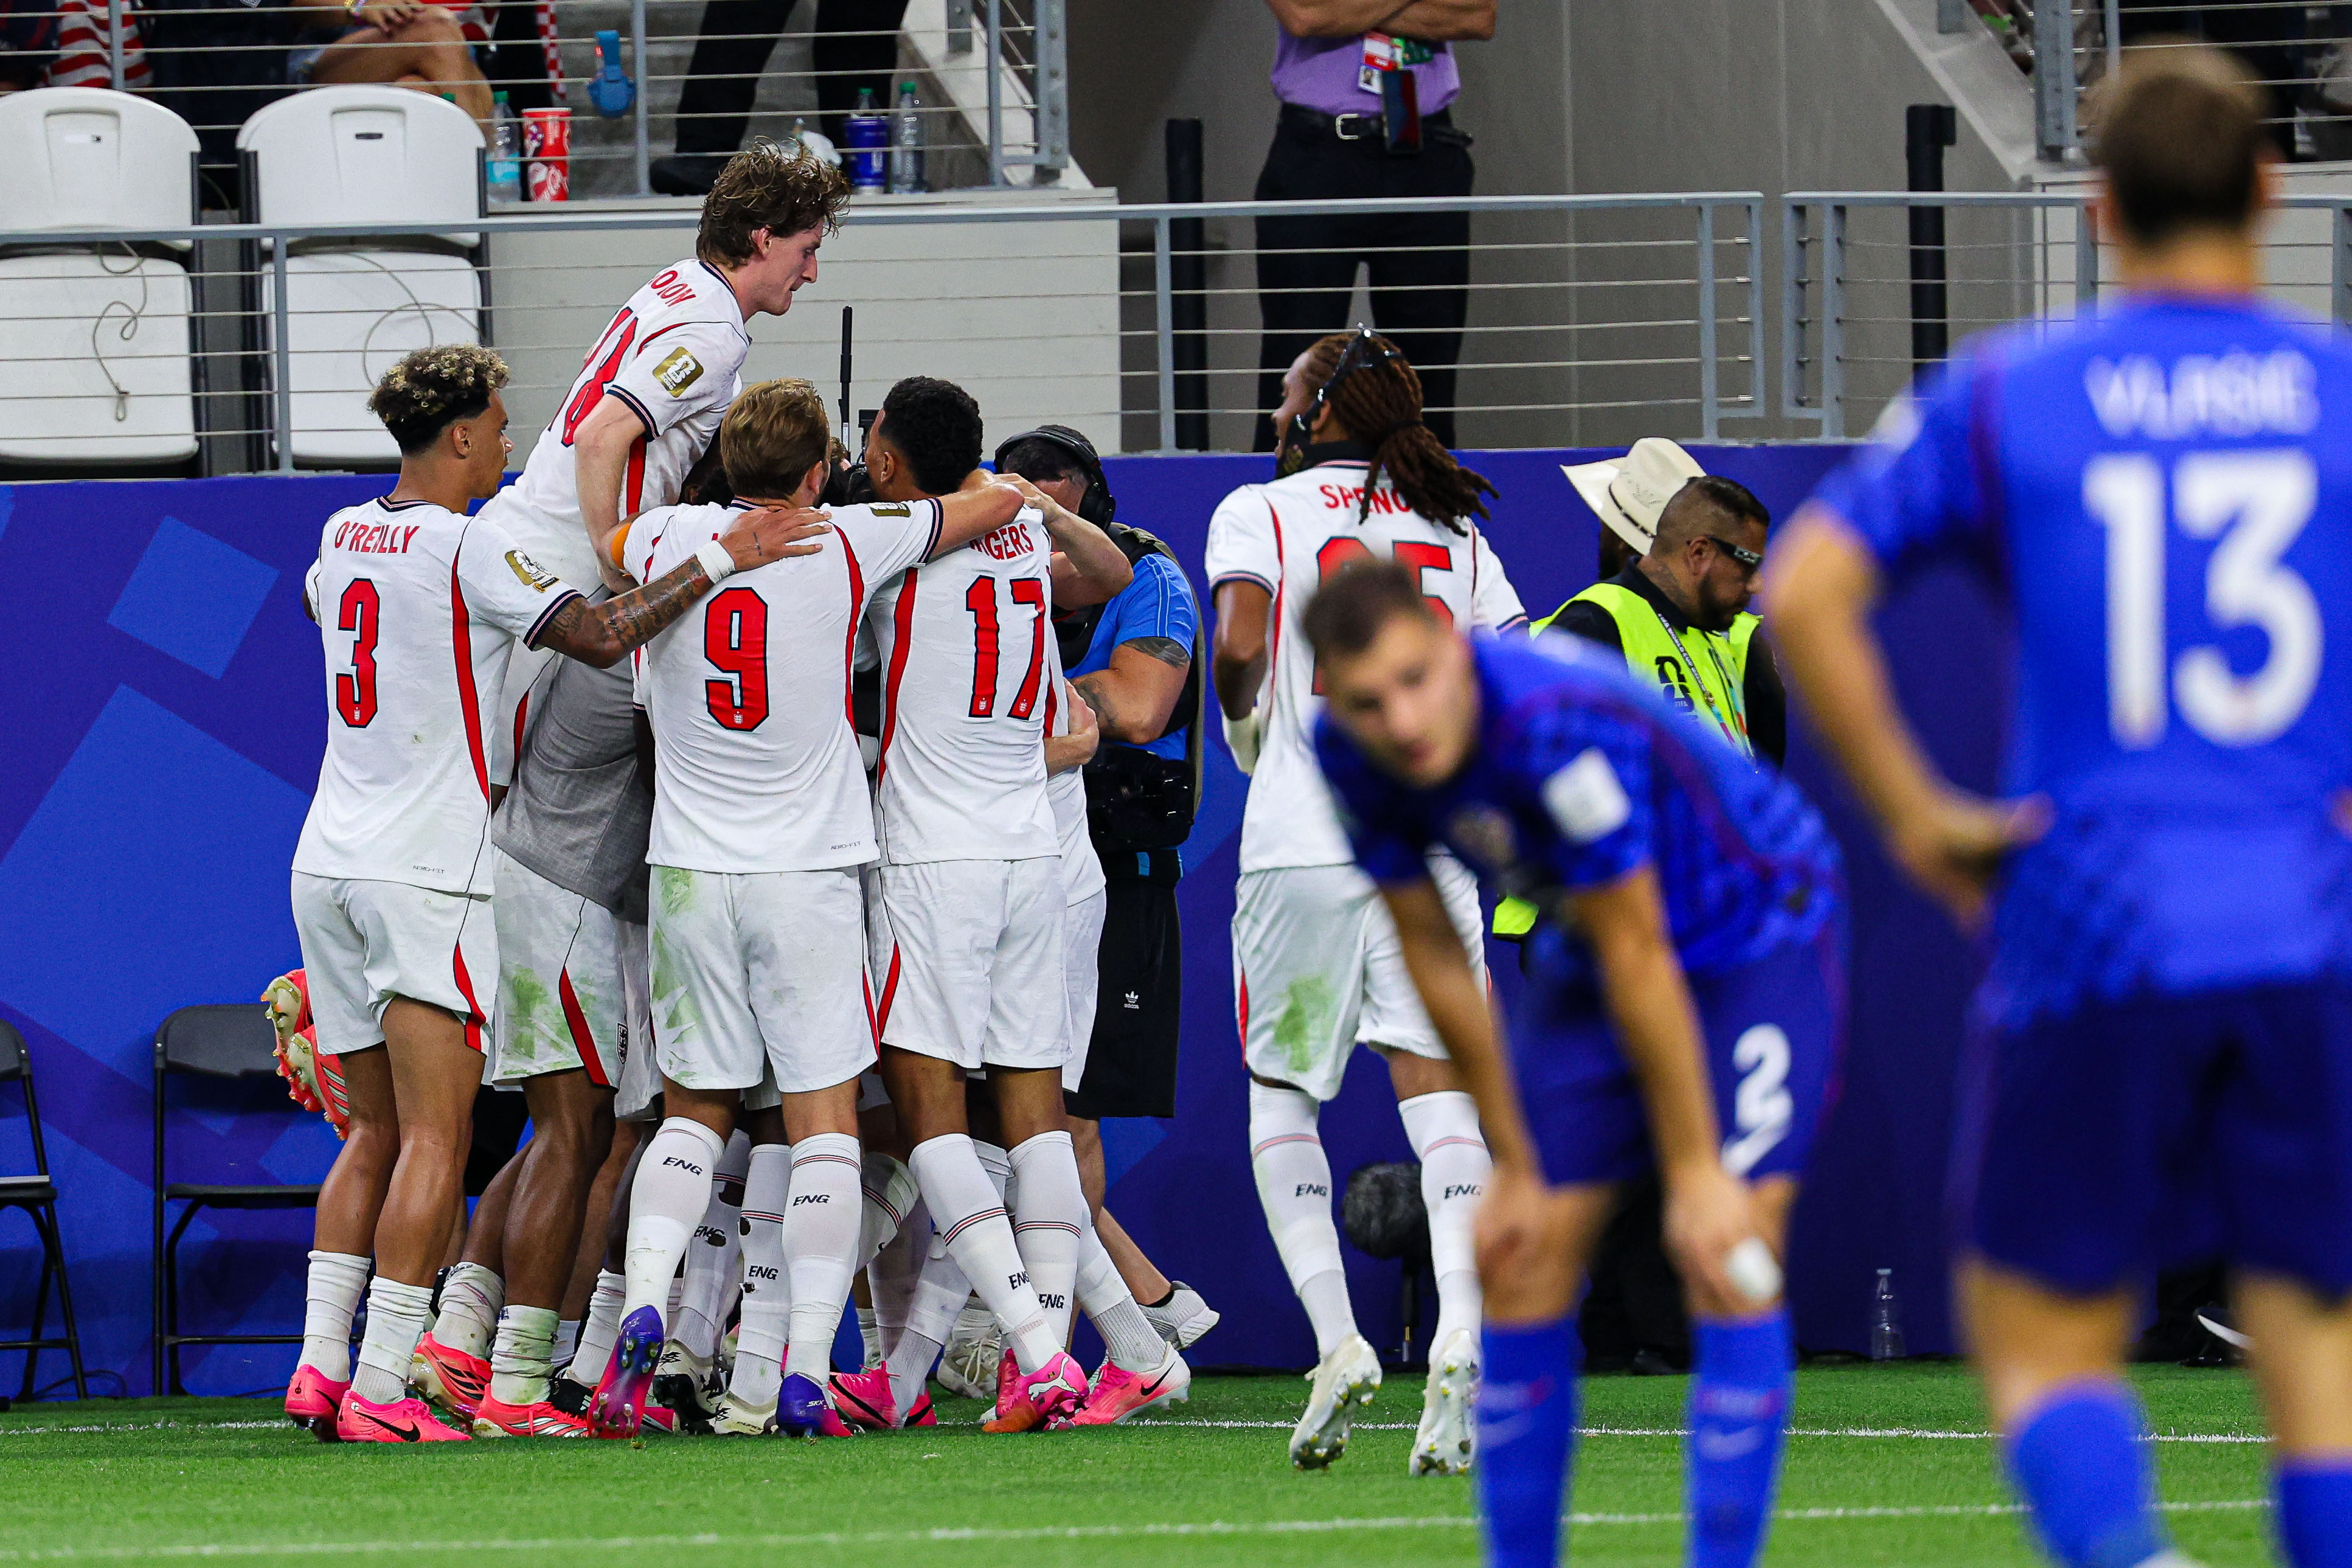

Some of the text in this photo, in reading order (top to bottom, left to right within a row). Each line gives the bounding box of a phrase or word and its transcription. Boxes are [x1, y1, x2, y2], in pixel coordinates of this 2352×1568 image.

[1319, 484, 1412, 515] SPENC
[335, 521, 420, 553] O'REILLY
[969, 523, 1035, 560] GERS
[2082, 449, 2325, 751] 13
[336, 578, 380, 728] 3
[704, 586, 770, 732] 9
[965, 575, 1046, 721] 17
[830, 841, 861, 850] AERO-FIT
[1733, 1022, 1794, 1130] 2
[662, 1156, 703, 1176] ENG
[793, 1194, 831, 1207] ENG
[1296, 1183, 1328, 1197] ENG
[1444, 1184, 1482, 1200] ENG
[748, 1265, 779, 1280] ENG
[1008, 1271, 1030, 1290] ENG
[1038, 1293, 1065, 1310] ENG
